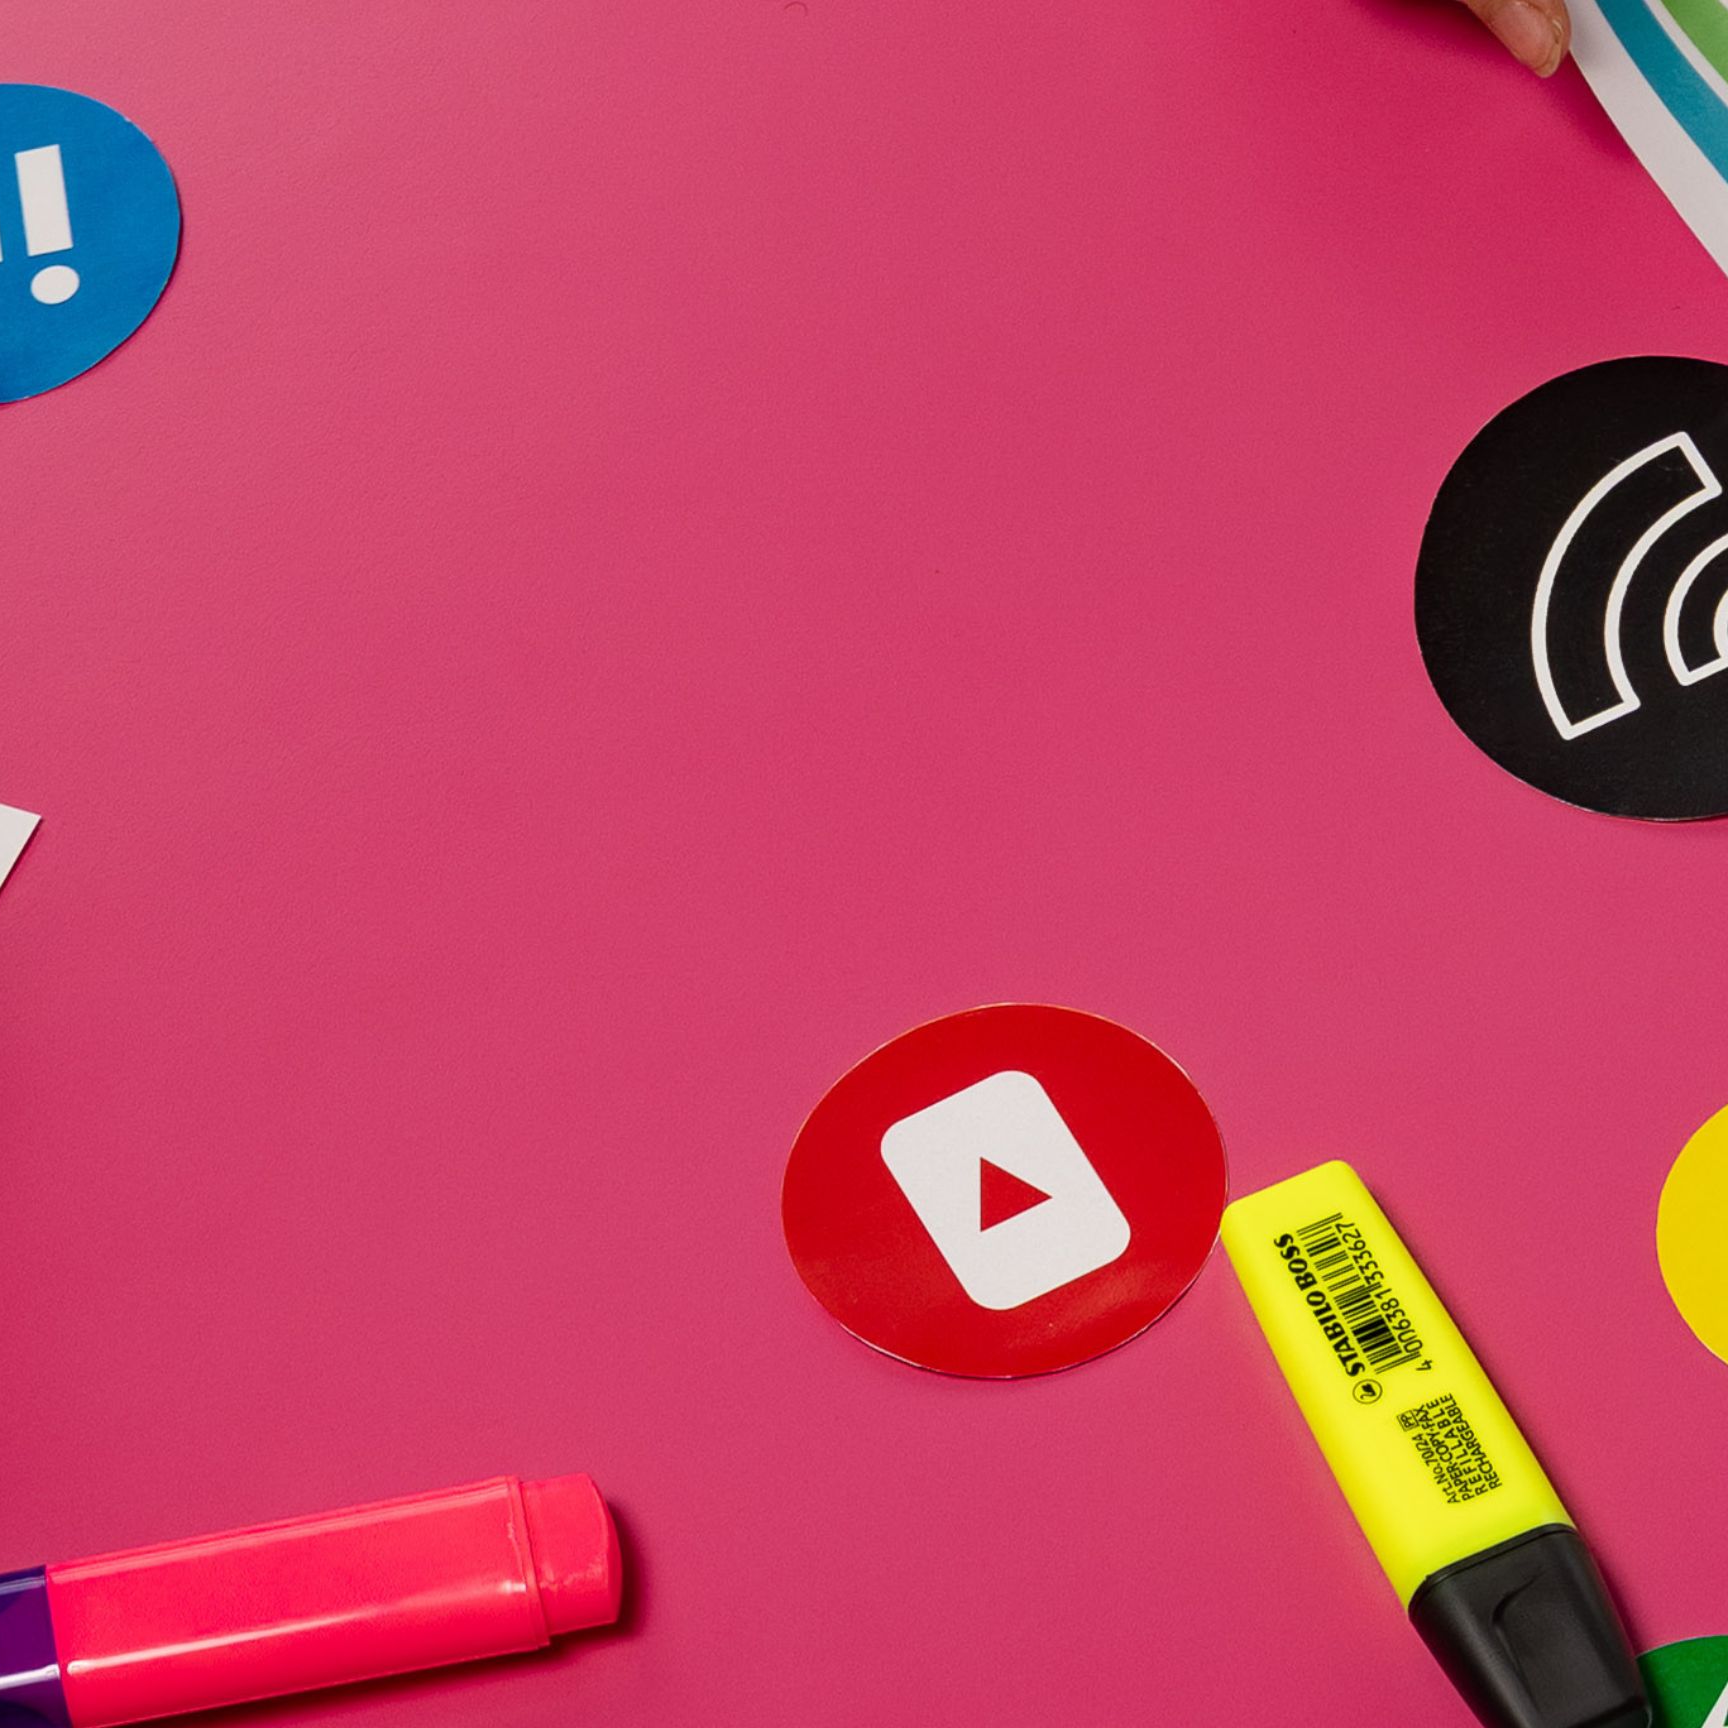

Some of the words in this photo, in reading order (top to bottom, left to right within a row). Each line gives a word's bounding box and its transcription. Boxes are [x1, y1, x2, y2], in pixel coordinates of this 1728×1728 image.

[1272, 1232, 1319, 1293] BOSS
[1334, 1223, 1383, 1284] 333627
[1304, 1289, 1367, 1378] STABILO
[1413, 1358, 1431, 1373] 4
[1426, 1398, 1488, 1495] REFILLABLE
[1439, 1393, 1502, 1489] RECHARGEABLE
